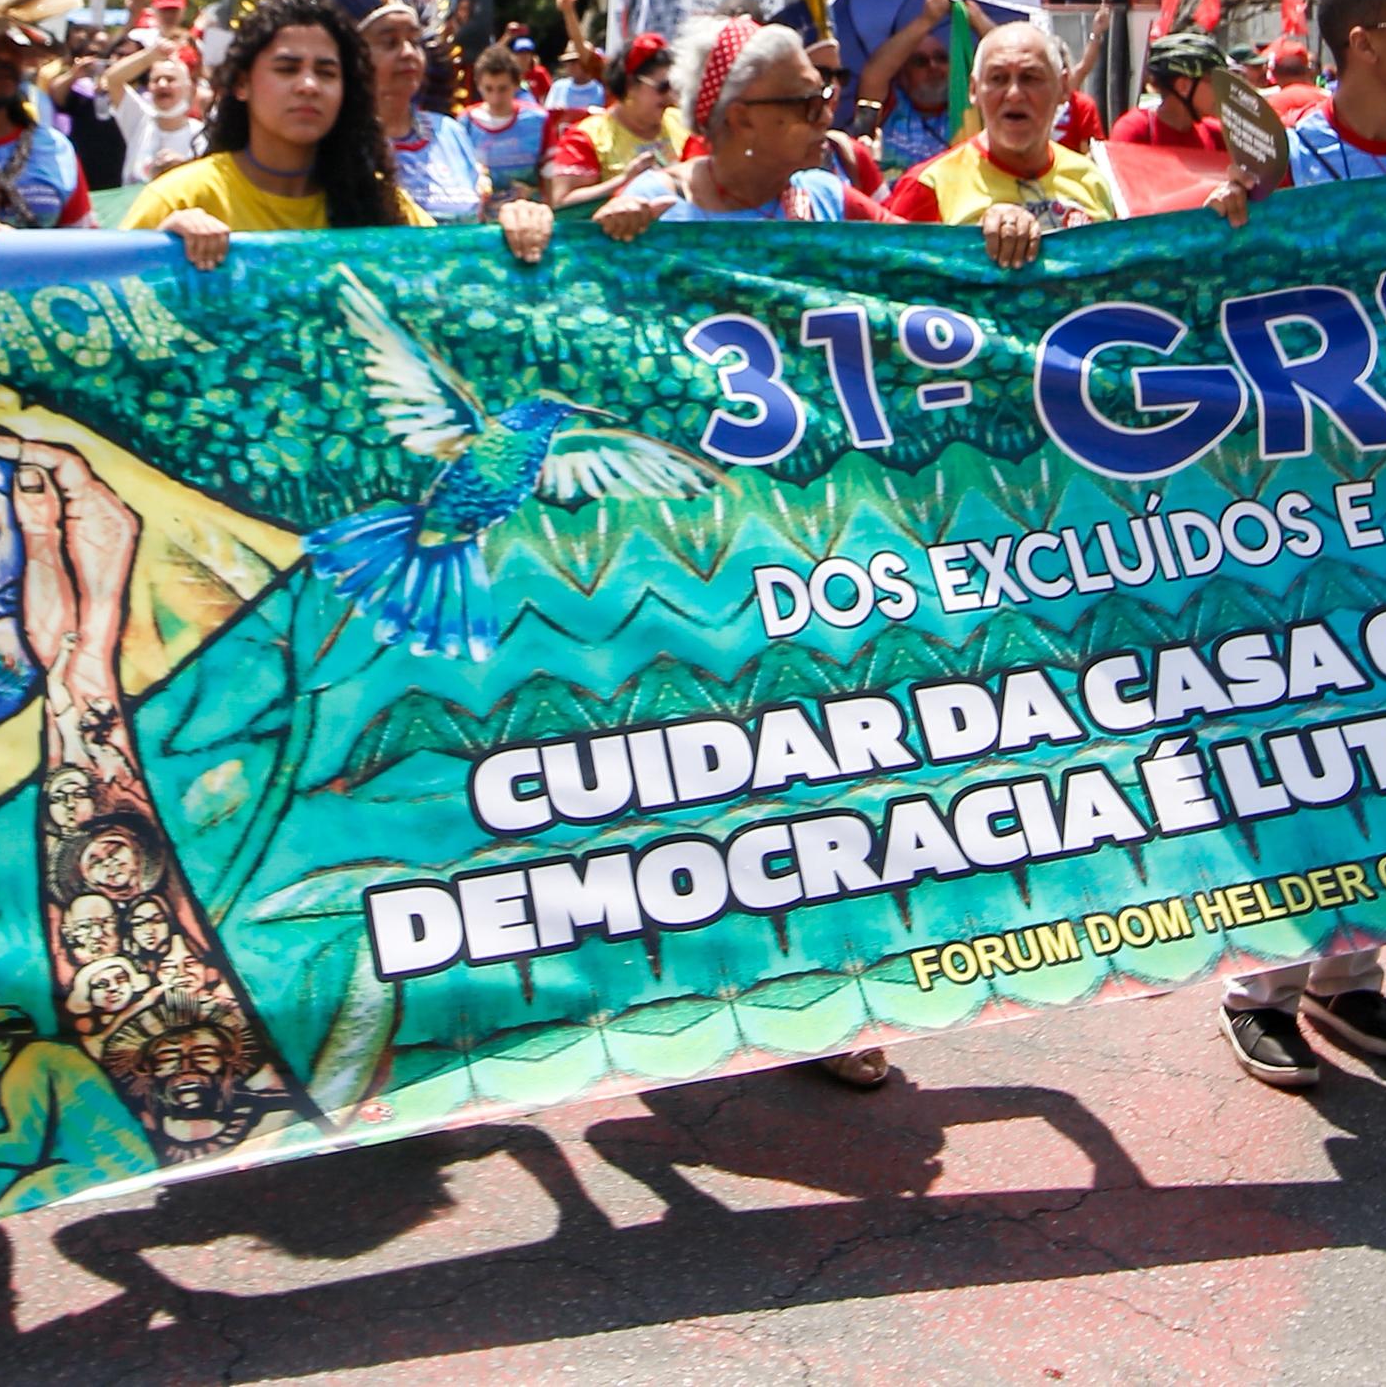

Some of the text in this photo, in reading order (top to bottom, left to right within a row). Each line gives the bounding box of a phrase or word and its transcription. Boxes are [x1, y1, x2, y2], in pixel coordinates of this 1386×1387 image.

[755, 550, 917, 638] DOS
[928, 493, 1322, 613] EXCLUÍDOS
[1336, 478, 1386, 549] E
[471, 695, 919, 834] CUIDAR
[917, 666, 1082, 763] DA
[1083, 619, 1371, 732] CASA
[366, 767, 1153, 981] DEMOCRACIA
[1138, 733, 1223, 835] É
[911, 923, 1079, 992] FORUM
[1088, 894, 1192, 961] DOM
[1201, 863, 1386, 931] HELDER
